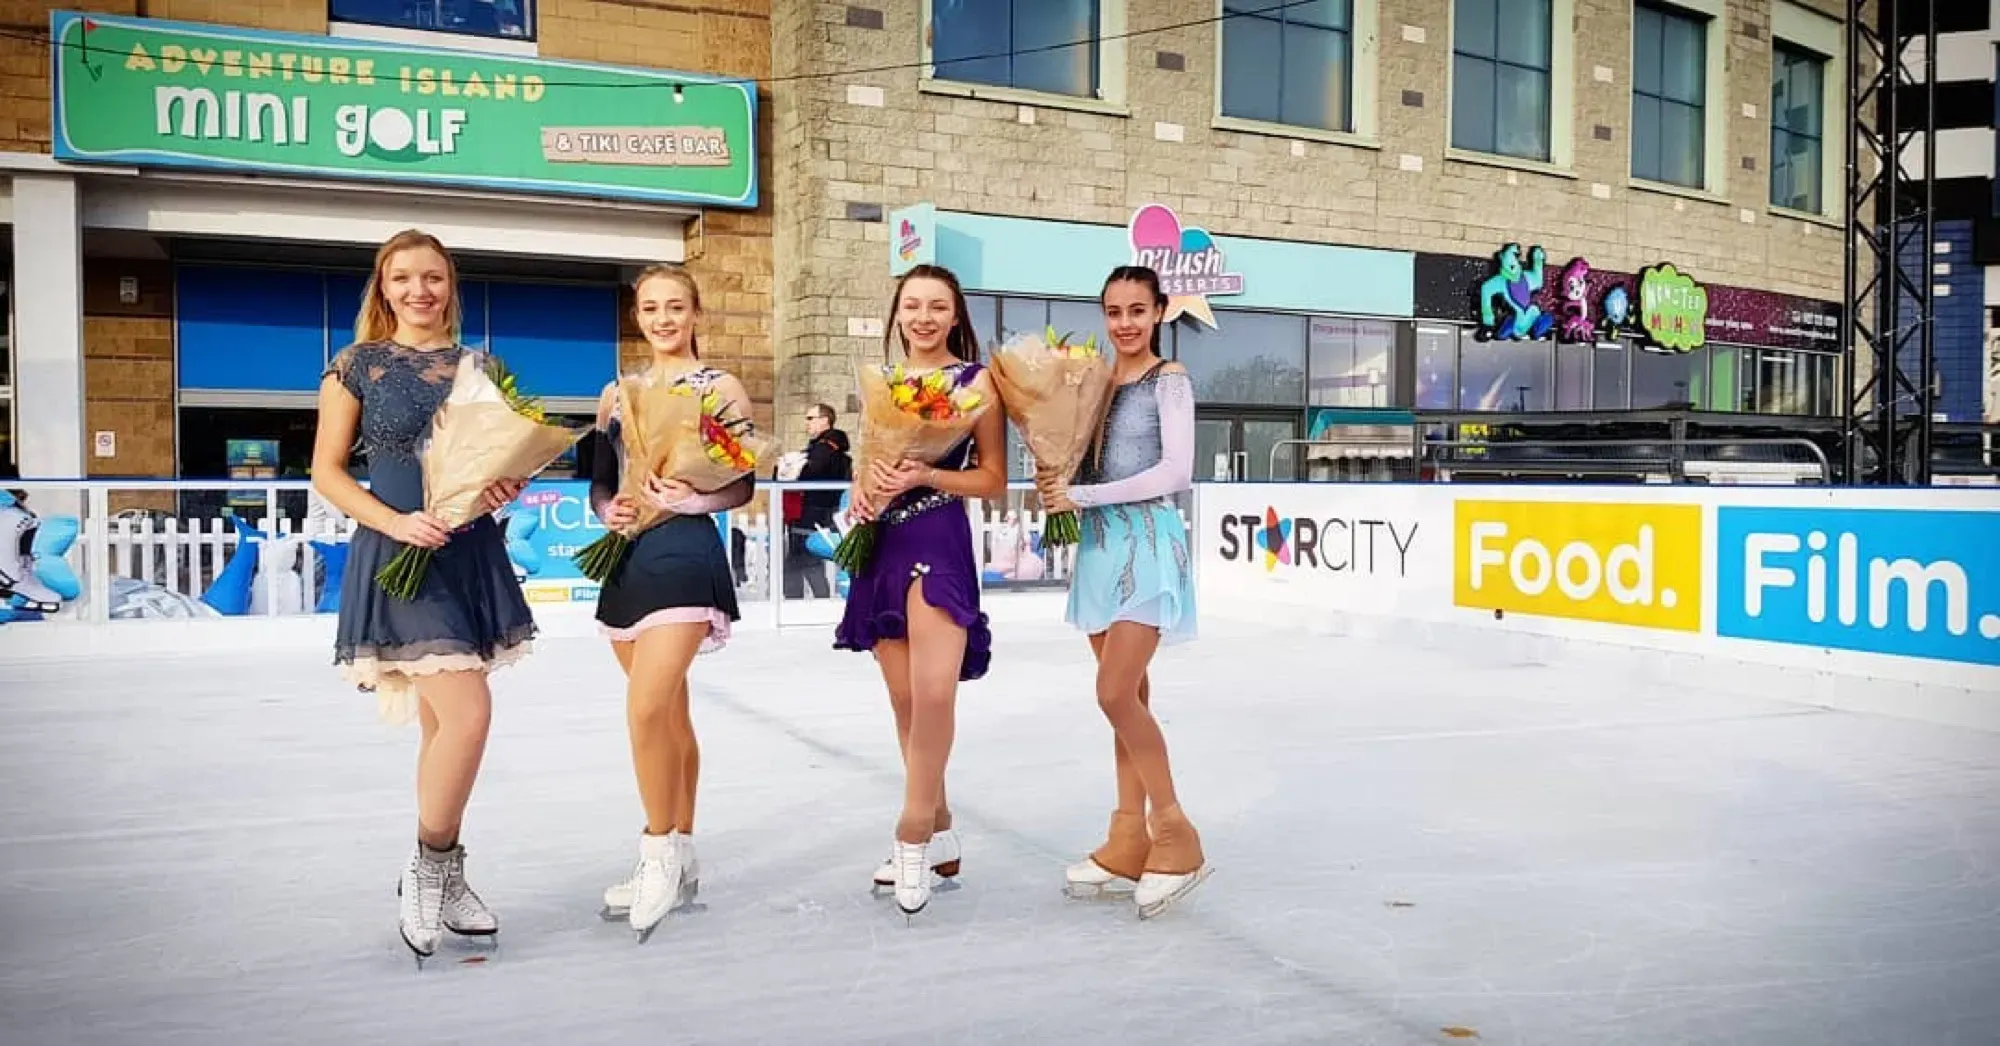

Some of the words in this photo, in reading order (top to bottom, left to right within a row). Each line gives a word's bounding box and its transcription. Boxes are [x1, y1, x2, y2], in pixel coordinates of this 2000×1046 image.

[124, 42, 376, 86] ADVENTURE
[399, 65, 546, 102] ISLAND
[557, 133, 571, 151] &
[579, 134, 620, 152] TIKI
[682, 138, 722, 154] BAR
[1161, 278, 1231, 294] SSERTS
[1470, 521, 1678, 608] Food.
[1744, 530, 2000, 640] Film.
